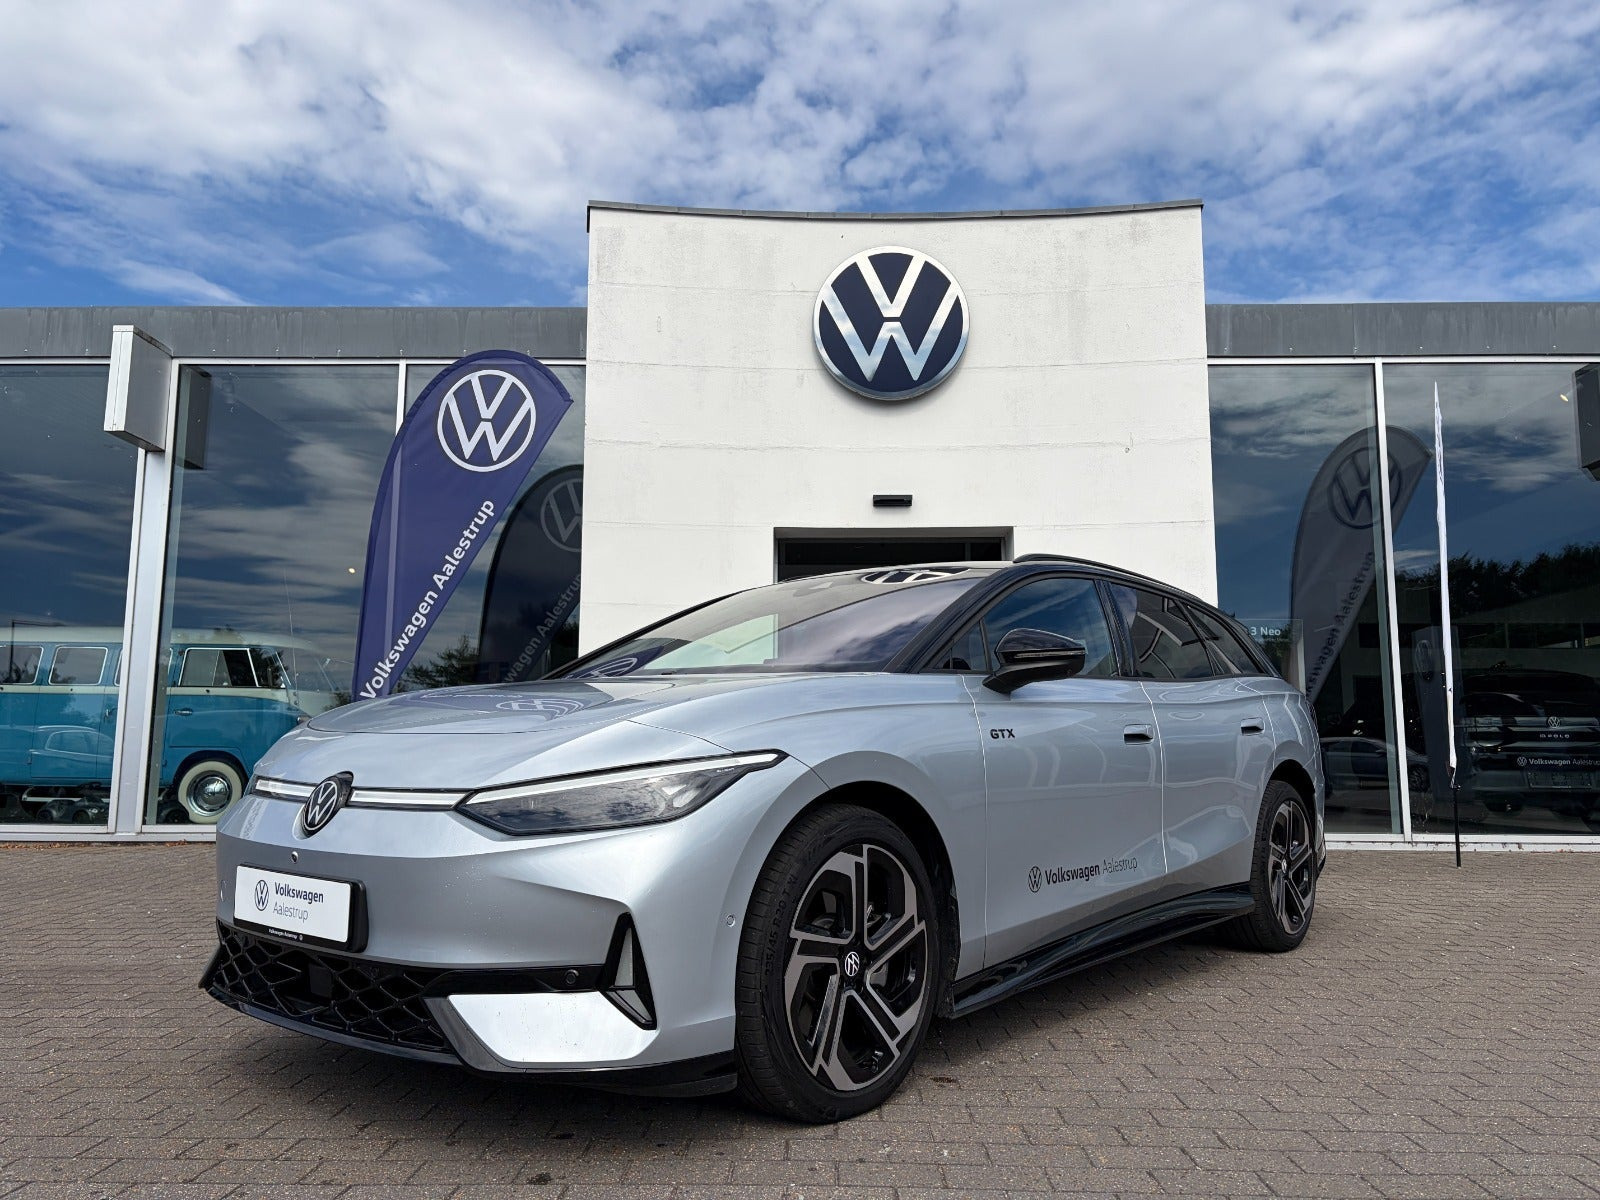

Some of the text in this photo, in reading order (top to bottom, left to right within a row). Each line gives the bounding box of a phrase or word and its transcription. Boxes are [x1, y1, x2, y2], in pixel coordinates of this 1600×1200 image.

[359, 499, 495, 699] Volkswagen Aalestrup
[1260, 626, 1281, 636] Neo
[989, 728, 1015, 740] GTX
[1528, 758, 1571, 767] Volkswagen
[1044, 863, 1100, 886] Volkswagen
[1102, 856, 1138, 875] Aalestrup
[274, 881, 324, 904] Volkswagen
[272, 902, 309, 923] Aalestrup
